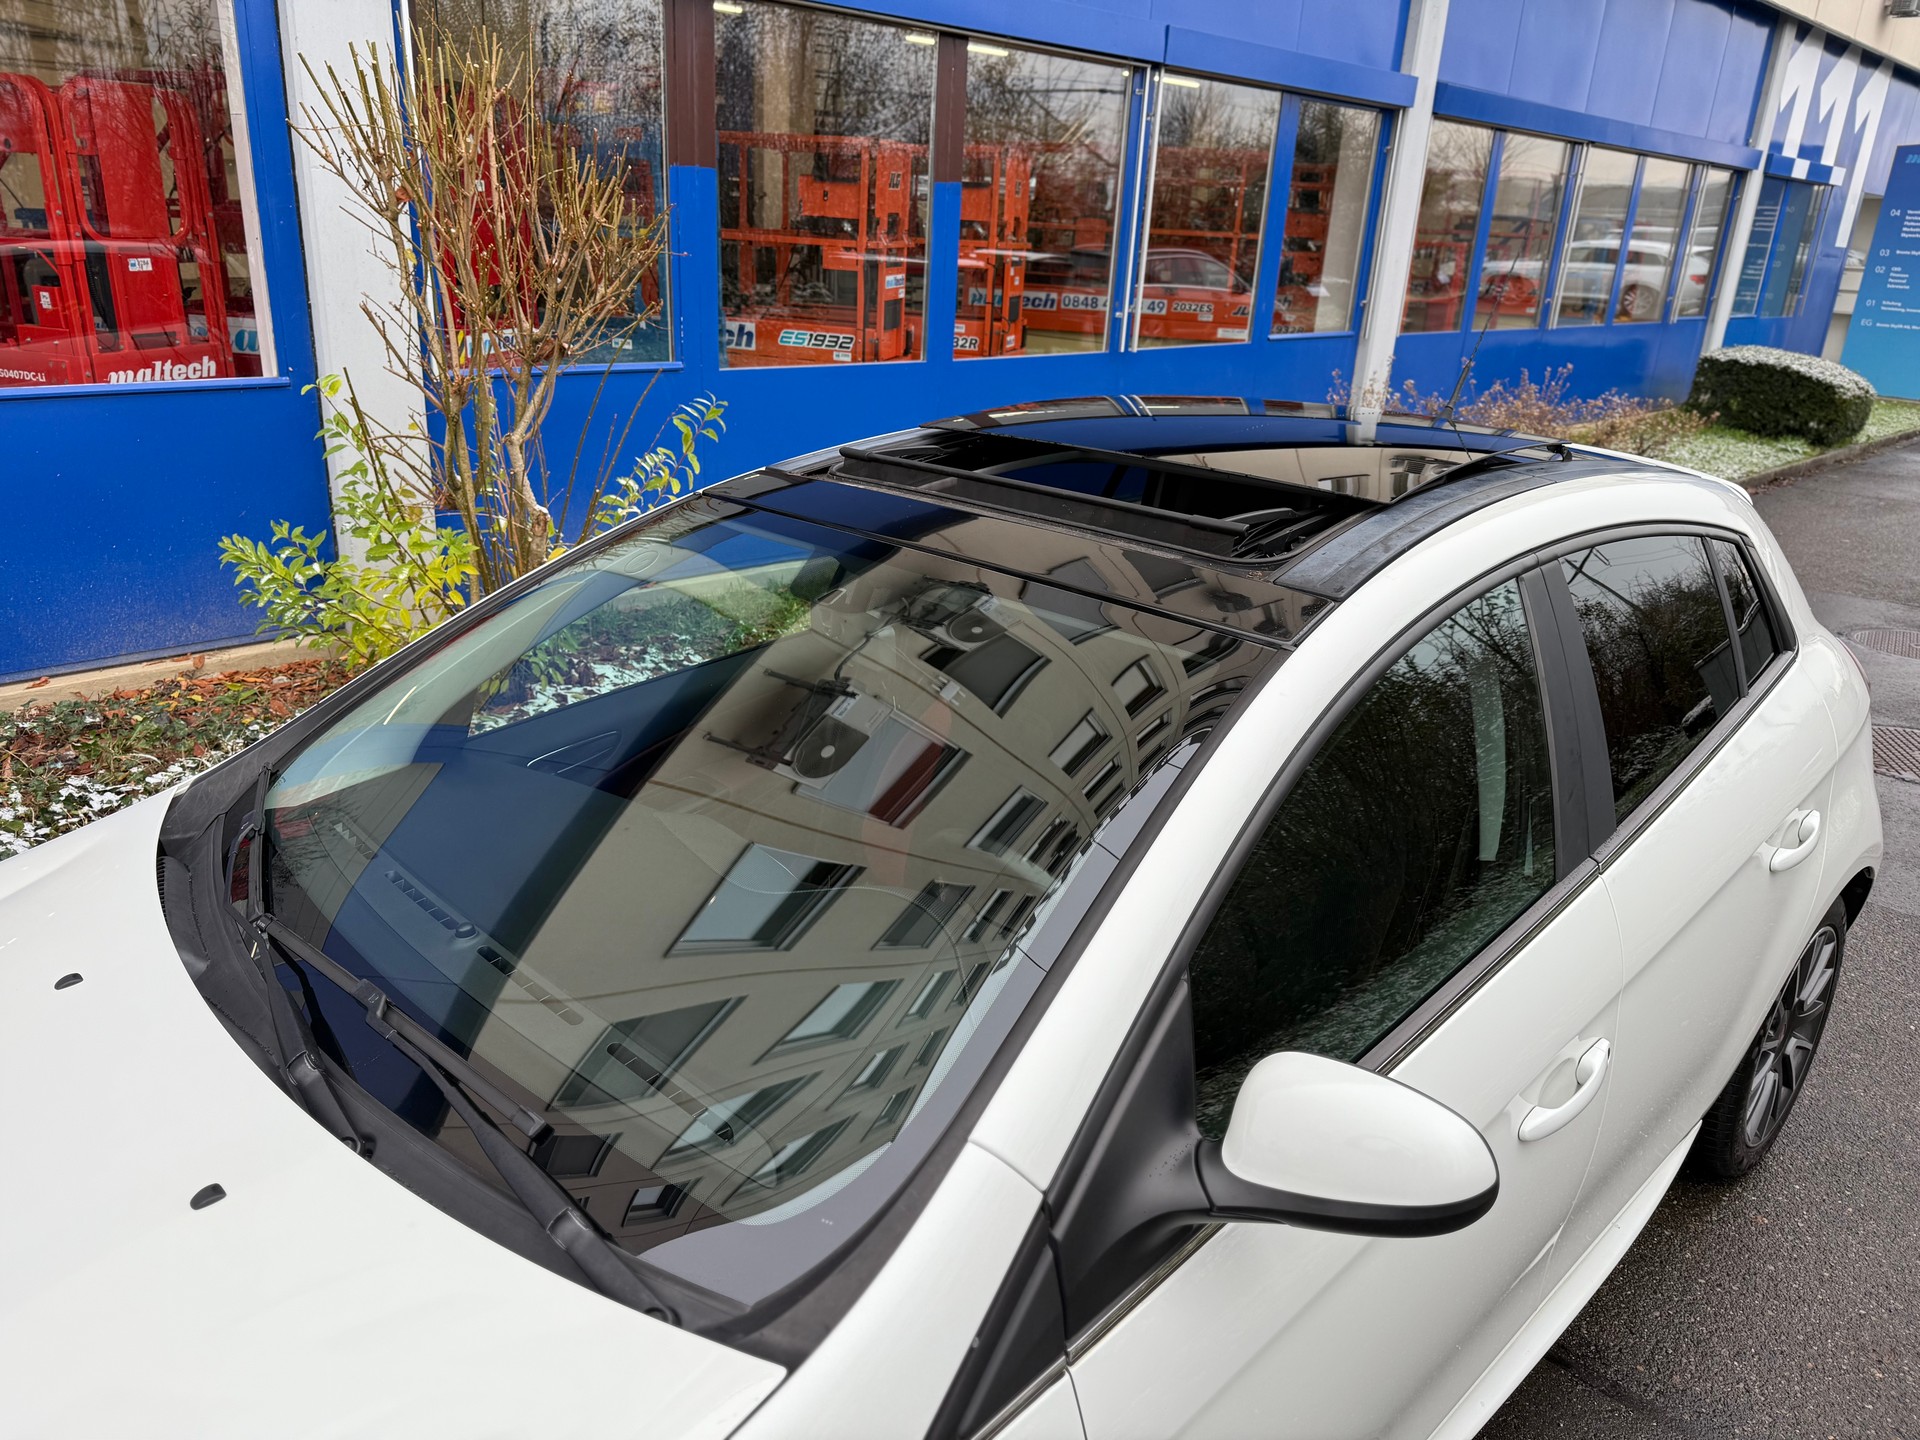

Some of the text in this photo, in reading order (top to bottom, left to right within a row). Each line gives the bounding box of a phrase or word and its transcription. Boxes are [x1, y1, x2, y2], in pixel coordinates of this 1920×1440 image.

[1780, 26, 1894, 248] 111
[1890, 208, 1901, 217] 04
[1879, 248, 1890, 257] 03
[1875, 265, 1886, 274] 02
[1063, 295, 1099, 309] 0848
[1147, 301, 1165, 313] 49
[1173, 302, 1212, 313] 2032ES
[1866, 299, 1876, 307] 01
[1860, 318, 1873, 327] EG
[779, 331, 854, 350] ES1932
[107, 355, 216, 385] maltech
